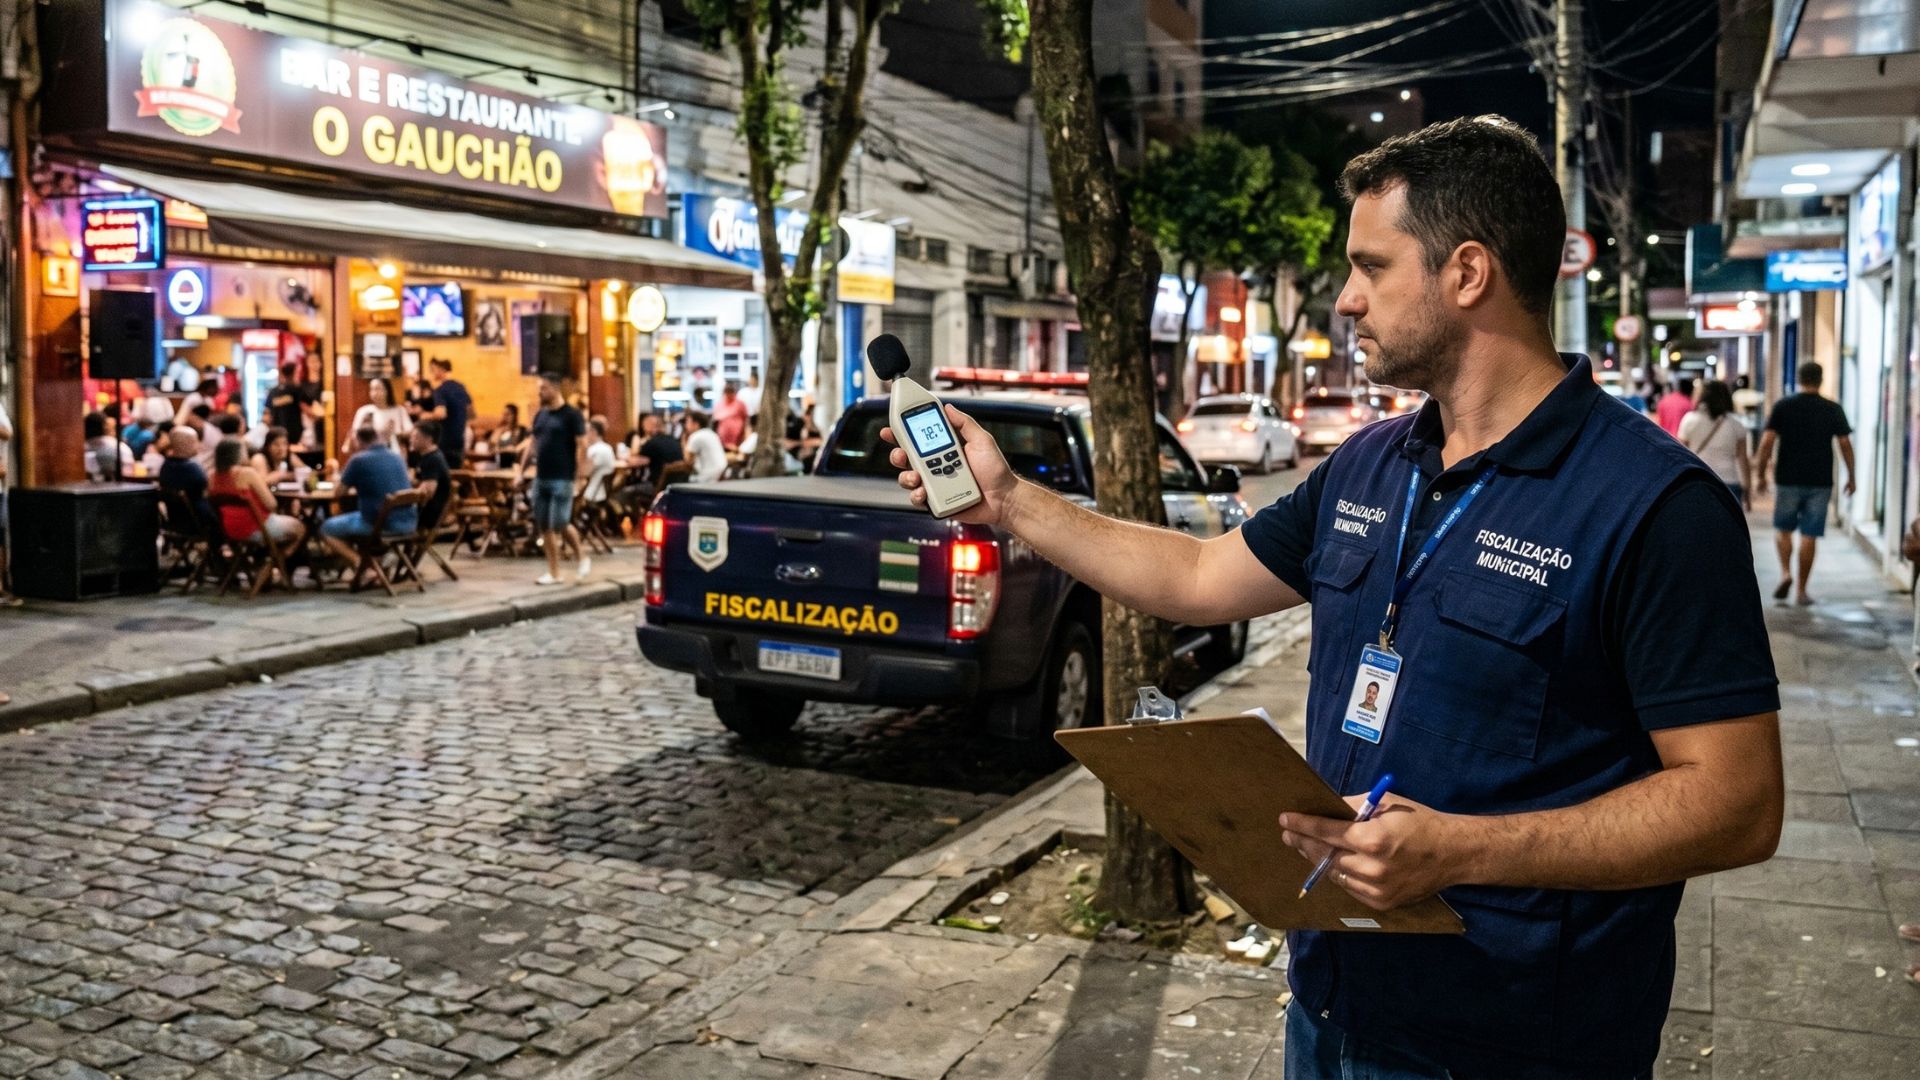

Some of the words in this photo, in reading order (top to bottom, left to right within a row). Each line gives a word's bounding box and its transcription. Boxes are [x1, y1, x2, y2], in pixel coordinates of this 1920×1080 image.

[280, 47, 351, 98] BAR
[358, 66, 382, 105] E
[387, 72, 583, 146] RESTAURANTE
[312, 105, 350, 157] O
[362, 114, 564, 193] GAUCHÃO
[1475, 529, 1573, 570] FISCALIZAÇÃO
[705, 591, 899, 636] FISCALIZAÇÃO
